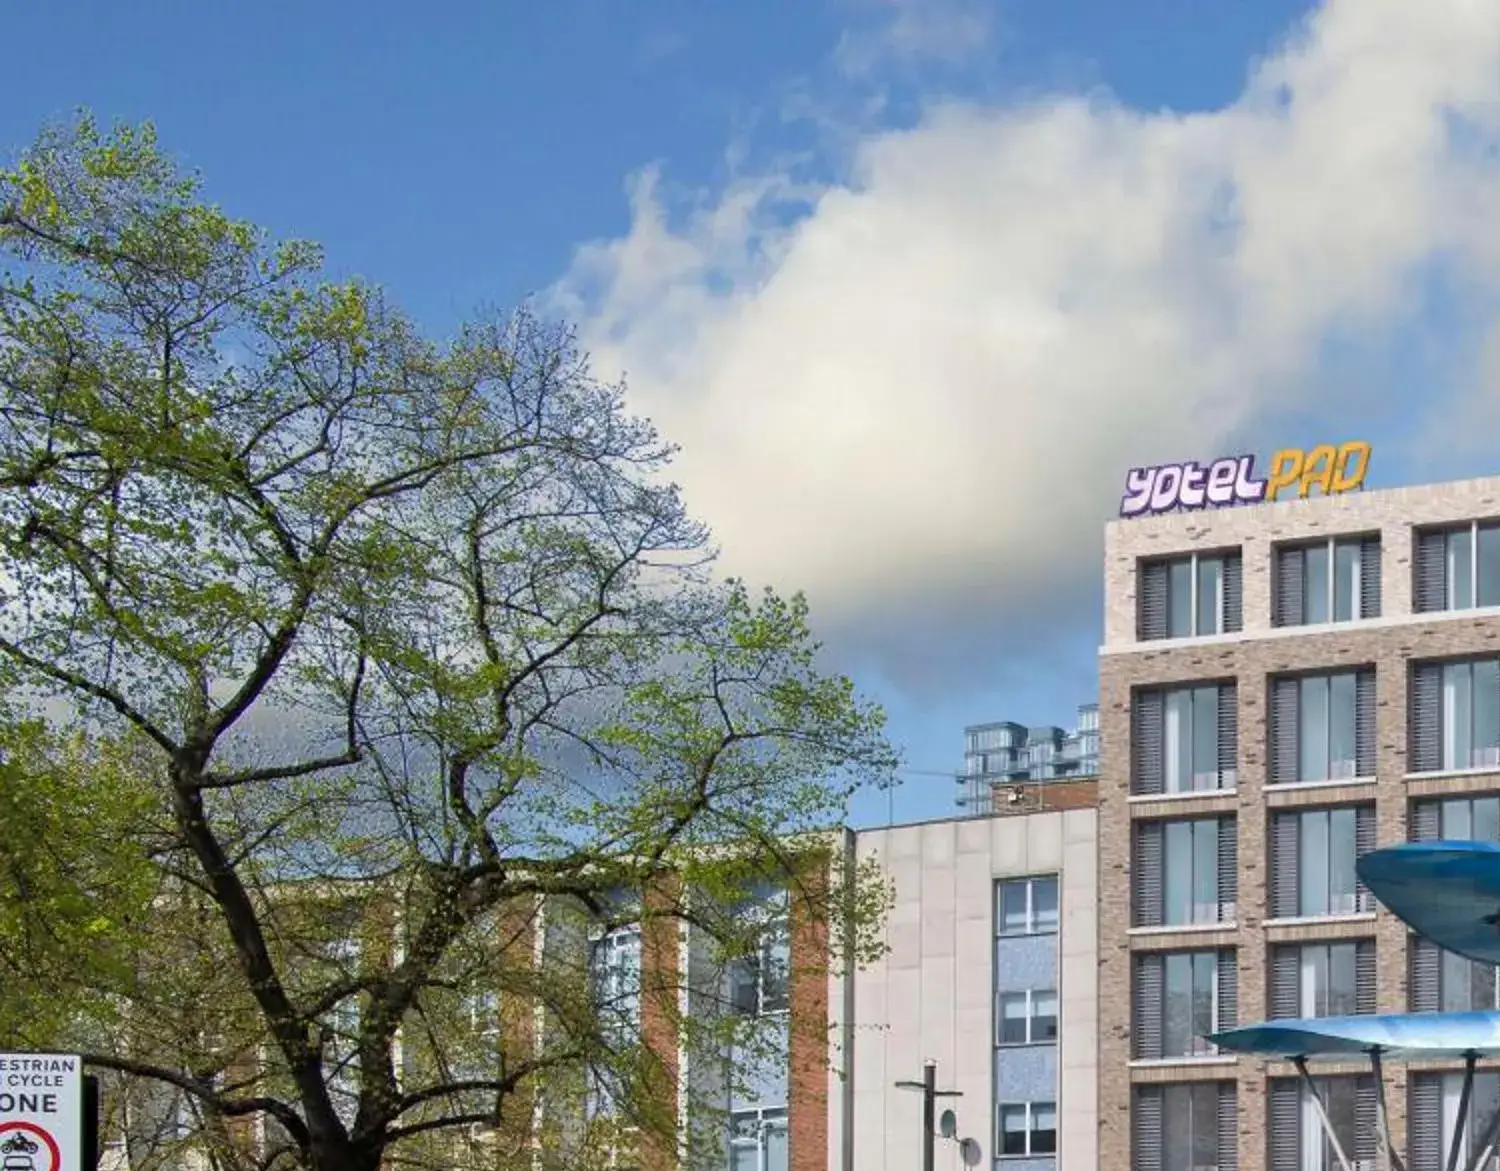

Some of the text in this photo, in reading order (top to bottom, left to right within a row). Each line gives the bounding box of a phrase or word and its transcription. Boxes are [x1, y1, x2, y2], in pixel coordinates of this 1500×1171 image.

[1266, 440, 1373, 502] PAD
[7, 1074, 64, 1087] CYCLE
[0, 1093, 57, 1113] ONE
